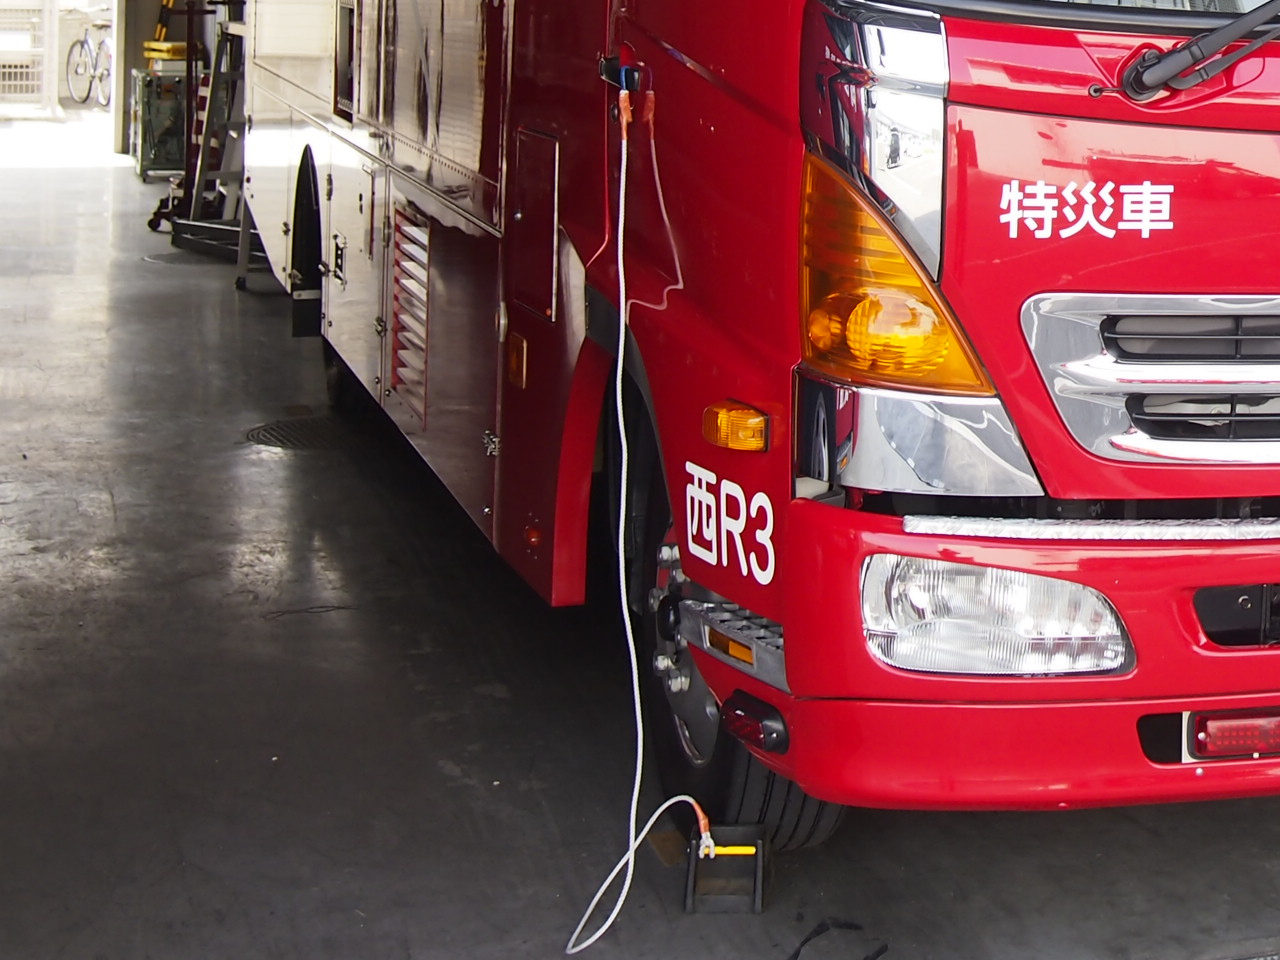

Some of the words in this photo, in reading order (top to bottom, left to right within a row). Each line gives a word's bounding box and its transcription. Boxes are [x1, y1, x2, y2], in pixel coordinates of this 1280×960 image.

[1000, 180, 1174, 238] 特災車
[685, 461, 775, 585] 西R3
